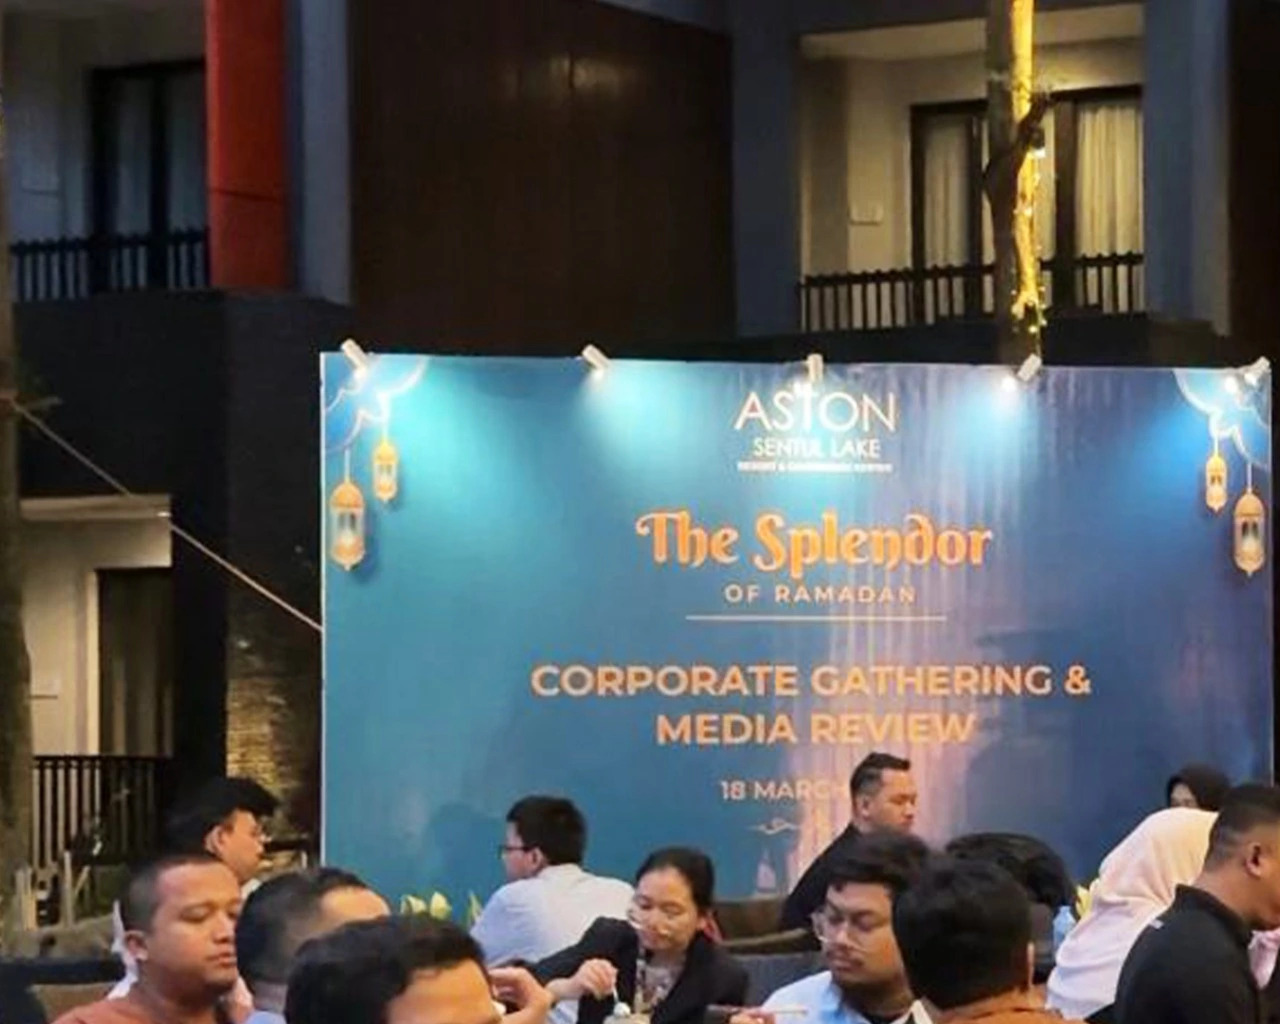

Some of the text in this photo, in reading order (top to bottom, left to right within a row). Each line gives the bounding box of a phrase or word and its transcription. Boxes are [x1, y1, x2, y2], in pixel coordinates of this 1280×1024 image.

[734, 389, 896, 432] ASTON
[829, 438, 882, 459] LAKE
[636, 512, 993, 579] The Splendor
[724, 584, 917, 605] OF RAMADAN
[530, 663, 1092, 698] CORPORATE GATHERING &
[656, 712, 978, 746] MEDIA REVIEW
[720, 780, 746, 800] 18
